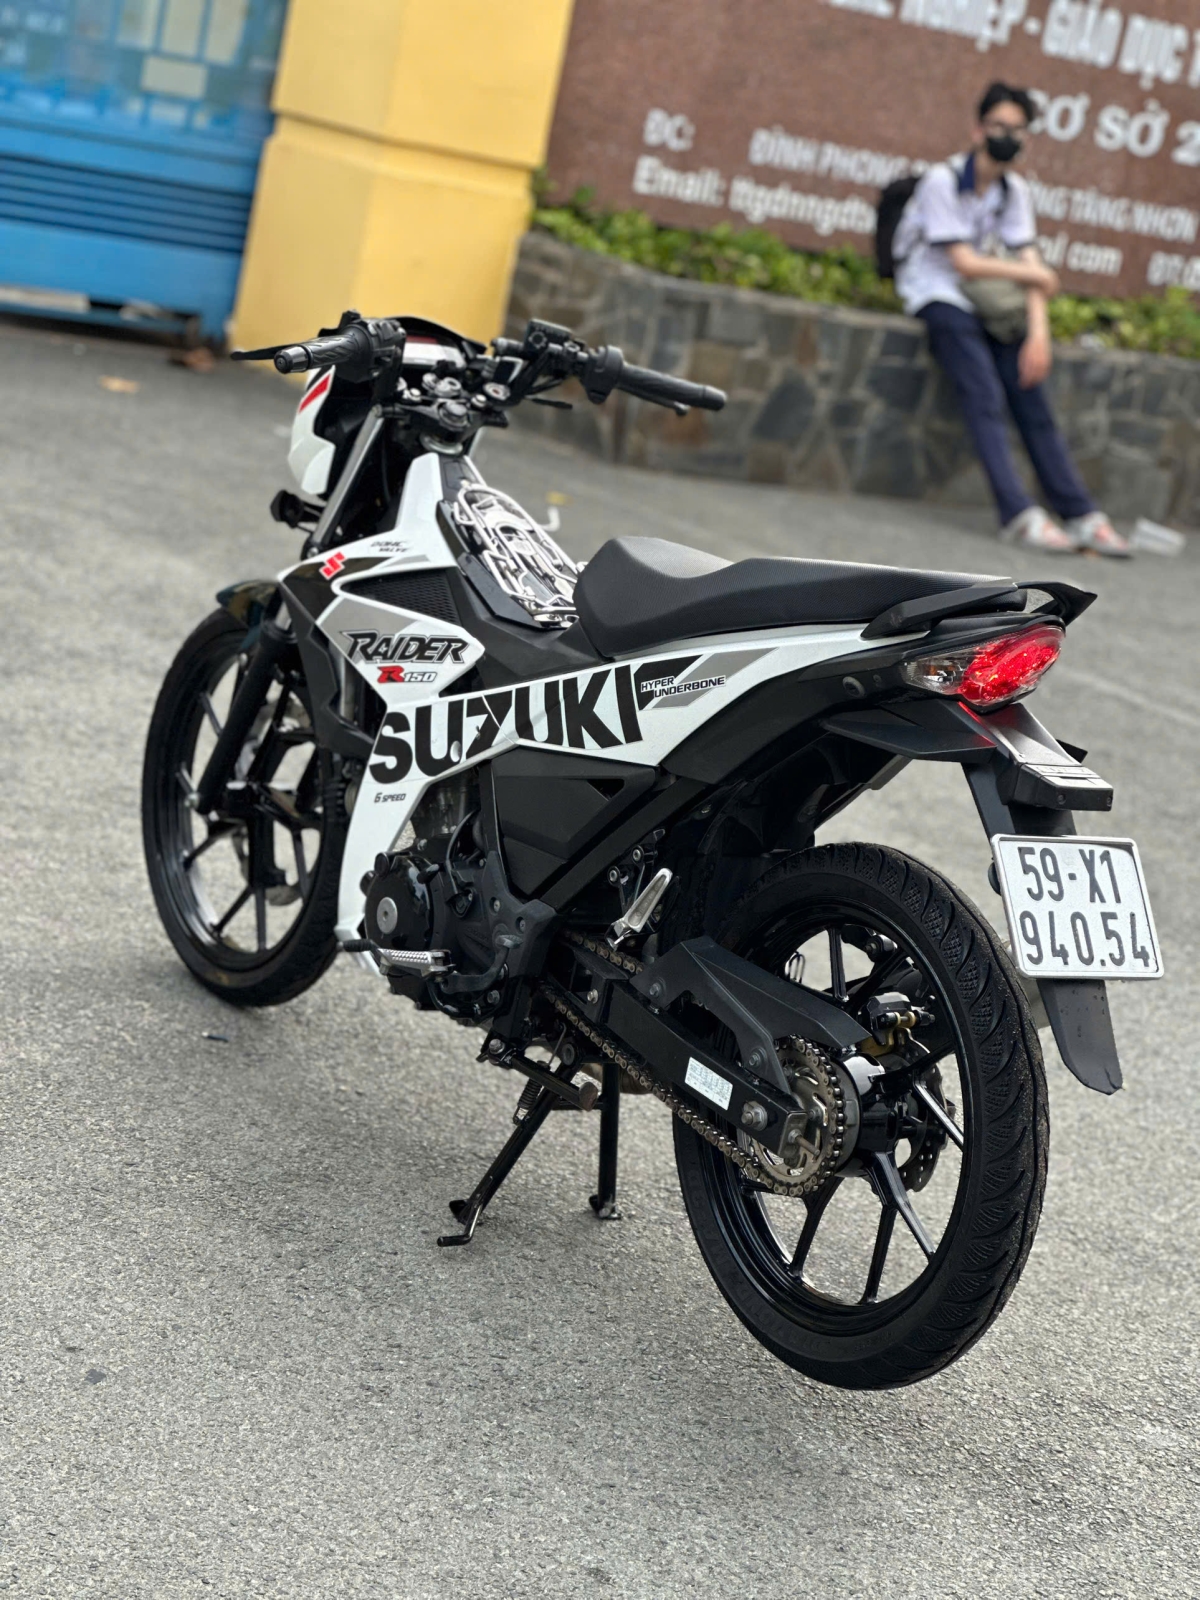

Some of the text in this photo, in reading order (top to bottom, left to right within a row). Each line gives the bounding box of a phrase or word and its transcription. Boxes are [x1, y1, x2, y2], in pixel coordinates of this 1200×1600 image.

[1094, 98, 1170, 157] SỞ
[633, 155, 726, 207] Email:
[339, 630, 469, 664] RAIDER
[641, 677, 675, 692] HYPER
[654, 676, 725, 698] UNDERBONE
[368, 663, 643, 784] SUZUKI
[374, 792, 406, 803] 6 SPEED
[1017, 846, 1122, 904] 59-X1
[1018, 910, 1152, 968] 940.54
